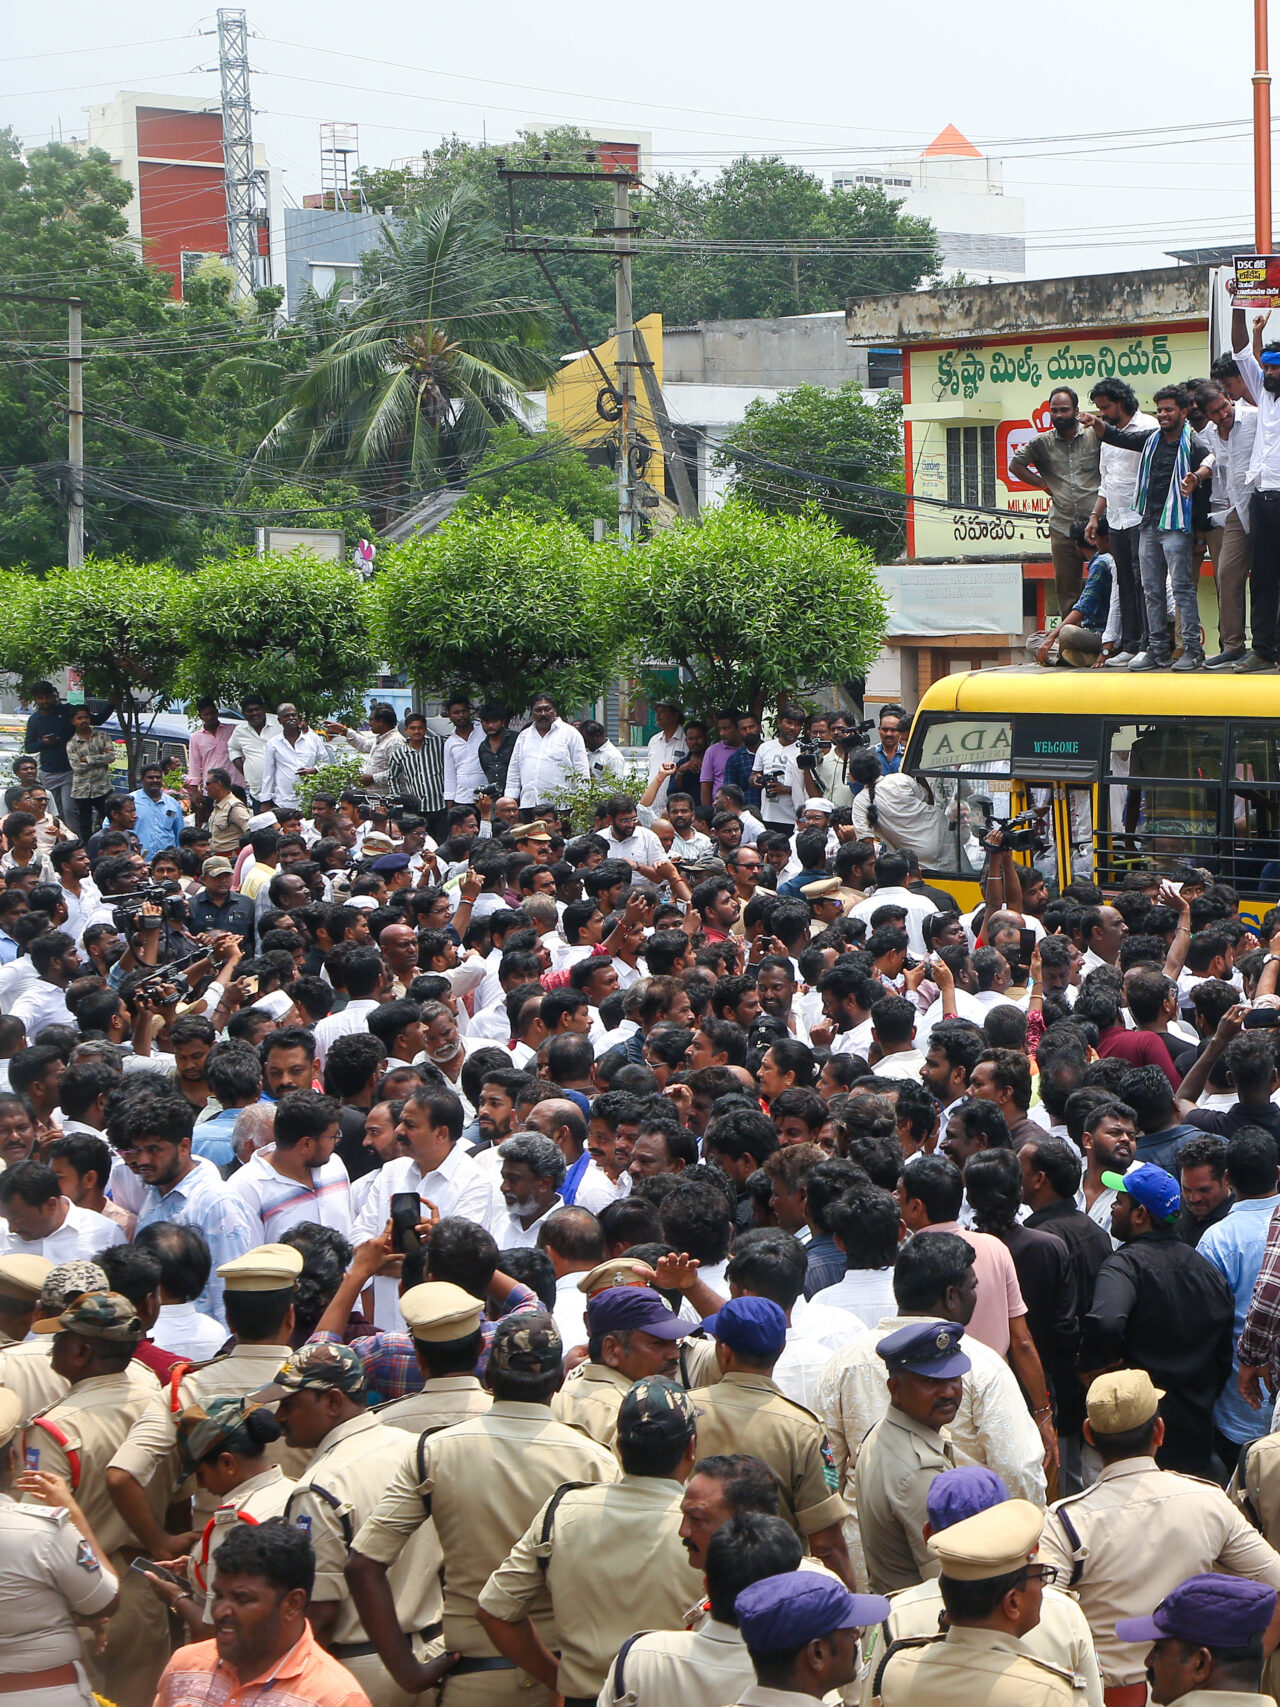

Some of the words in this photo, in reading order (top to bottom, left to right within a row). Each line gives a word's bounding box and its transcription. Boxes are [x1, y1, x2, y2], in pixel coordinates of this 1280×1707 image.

[1238, 260, 1253, 269] DSC
[937, 350, 985, 399] కృష్ణా
[990, 346, 1042, 388] మిల్క్
[1047, 336, 1172, 380] యూనియన్
[1008, 499, 1027, 512] MILK
[988, 780, 1011, 791] STOP
